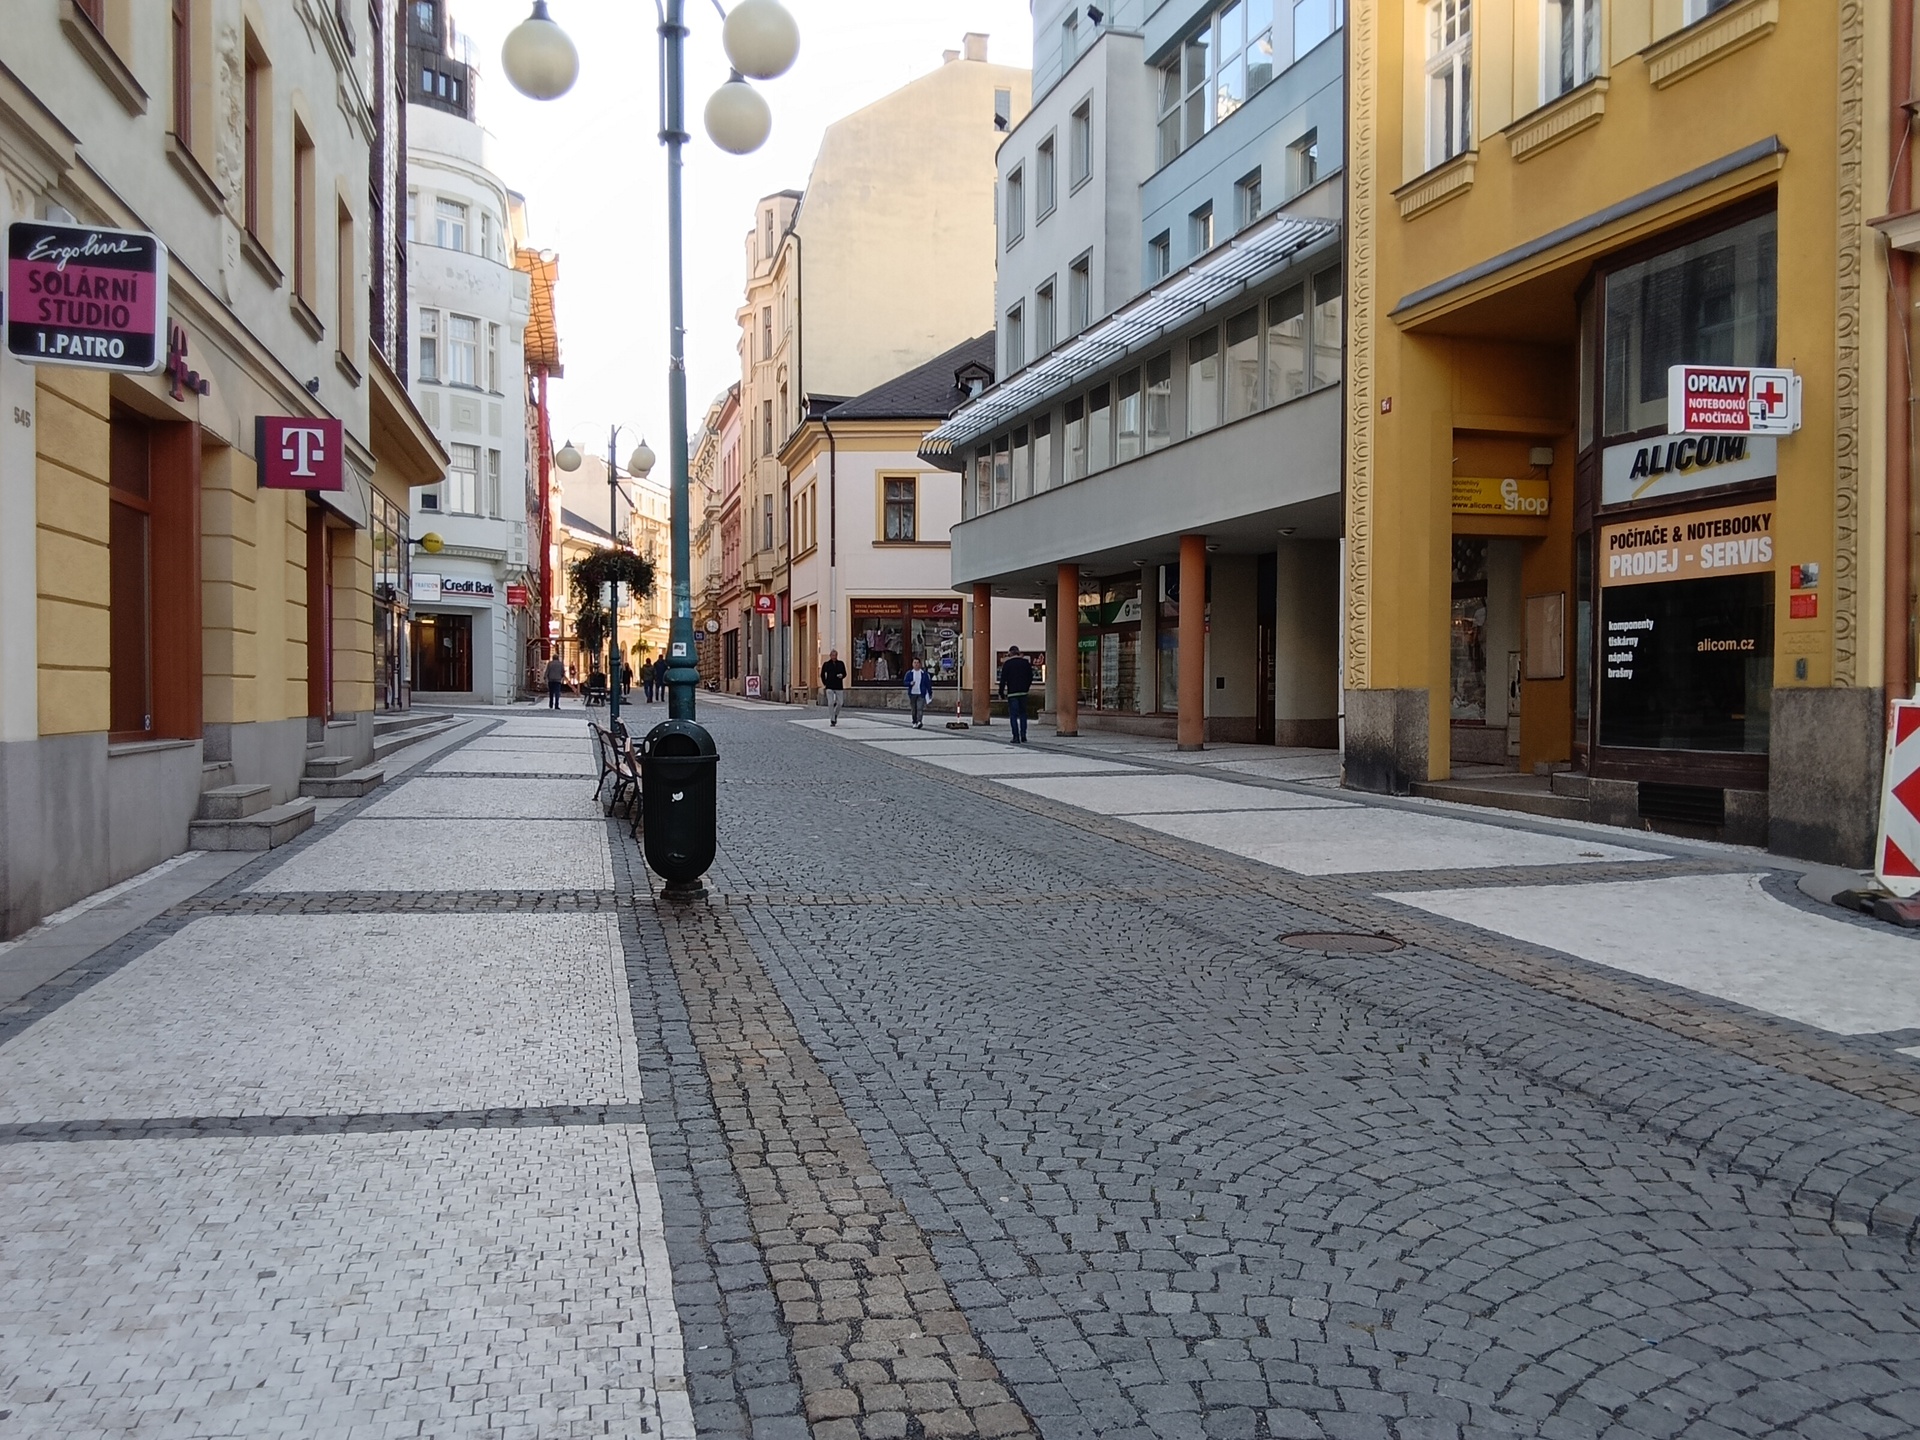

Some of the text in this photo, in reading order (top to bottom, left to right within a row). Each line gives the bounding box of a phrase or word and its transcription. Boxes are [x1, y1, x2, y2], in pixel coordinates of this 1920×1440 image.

[27, 233, 143, 272] Ergoline
[28, 267, 138, 303] SOLÁRNÍ
[38, 297, 131, 329] STUDIO
[37, 331, 125, 359] 1.PATRO
[1687, 374, 1747, 395] OPRAVY
[1688, 398, 1746, 411] NOTEBOOKŮ
[13, 405, 31, 428] 545
[1691, 411, 1744, 425] A POČÍTAČŮ
[281, 427, 325, 476] T
[1630, 436, 1748, 480] ALICOM
[1610, 513, 1772, 550] POČÍTAČE & NOTEBOOKY
[1609, 548, 1679, 578] PRODEJ
[1700, 536, 1773, 569] SERVIS
[441, 578, 494, 594] iCredit Bank
[1608, 618, 1655, 632] komponenty
[1608, 635, 1639, 648] tiskárny
[1697, 638, 1755, 652] alicom.cz
[1608, 651, 1633, 664] náplně
[1608, 667, 1633, 680] brašny
